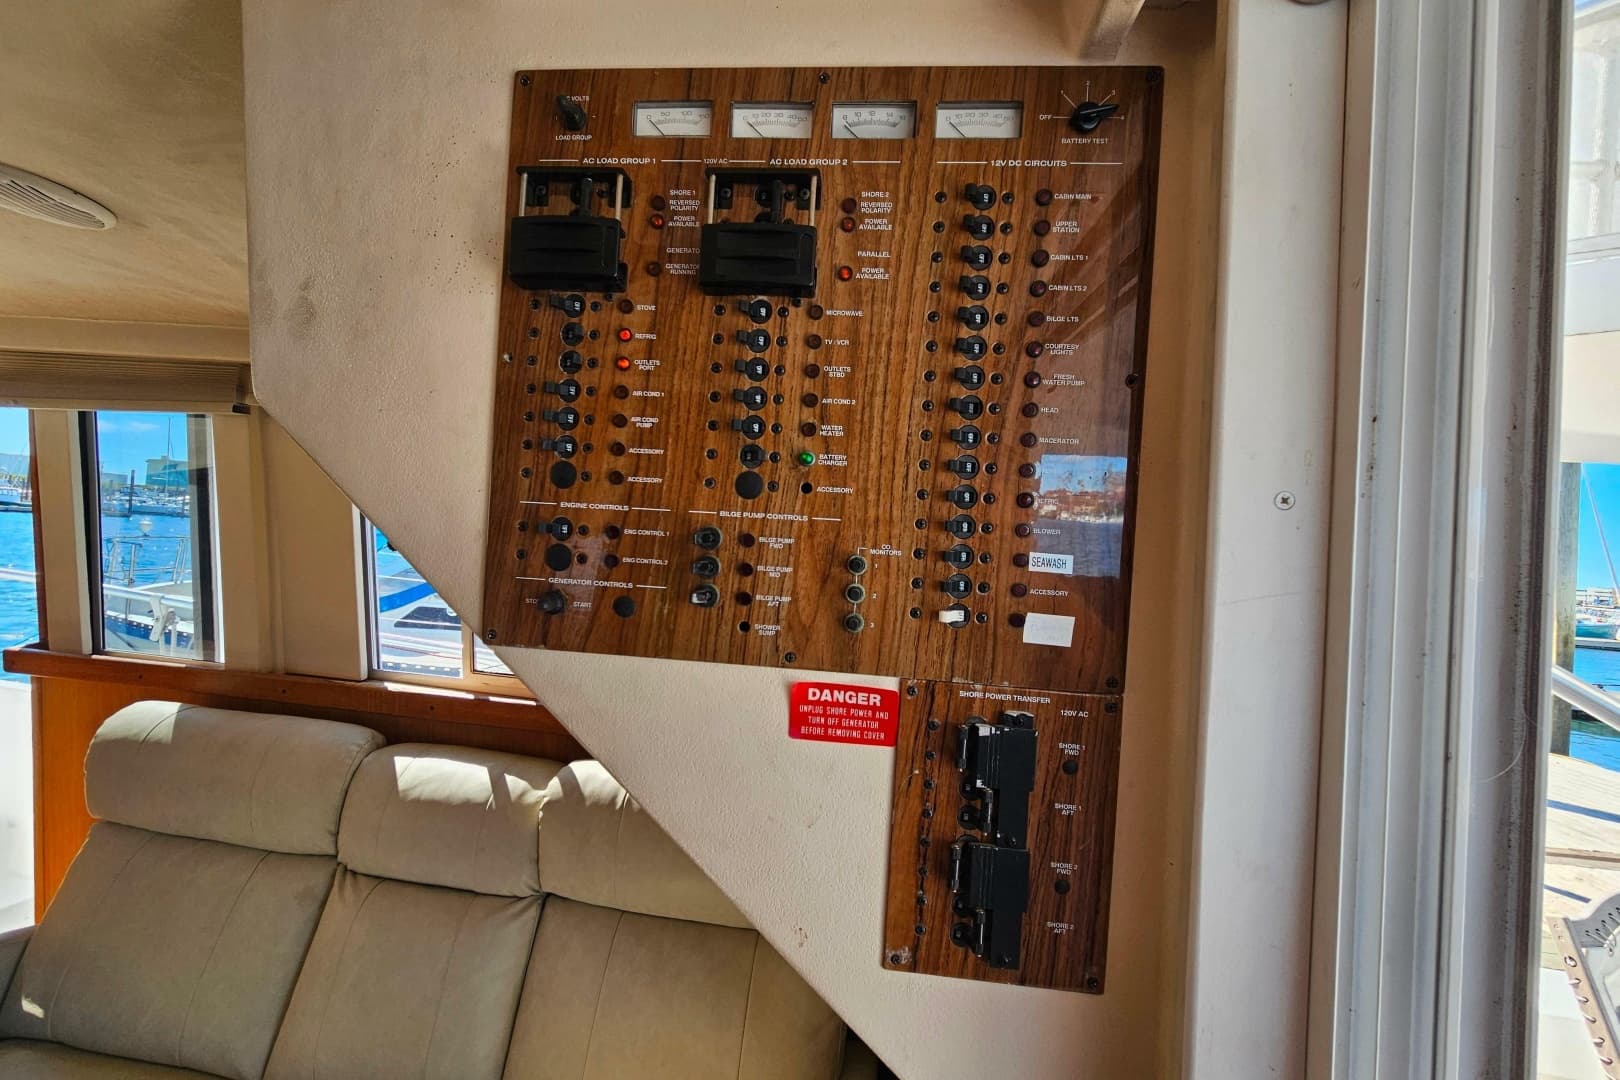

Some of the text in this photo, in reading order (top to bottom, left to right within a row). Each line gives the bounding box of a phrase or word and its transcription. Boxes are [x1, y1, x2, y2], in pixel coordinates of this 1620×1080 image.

[766, 513, 808, 521] CONTROLS
[1031, 557, 1067, 568] SEAWASH
[548, 578, 633, 588] GENERATOR CONTROLS
[808, 688, 881, 706] DANGER
[960, 691, 984, 699] SHORE
[1013, 695, 1050, 704] TRANSFER
[799, 705, 823, 713] UNPLUG
[826, 707, 847, 716] SHORE
[850, 709, 872, 717] POWER
[842, 719, 879, 728] GENERATOR
[801, 726, 885, 740] BEFORE REMOVING COVER
